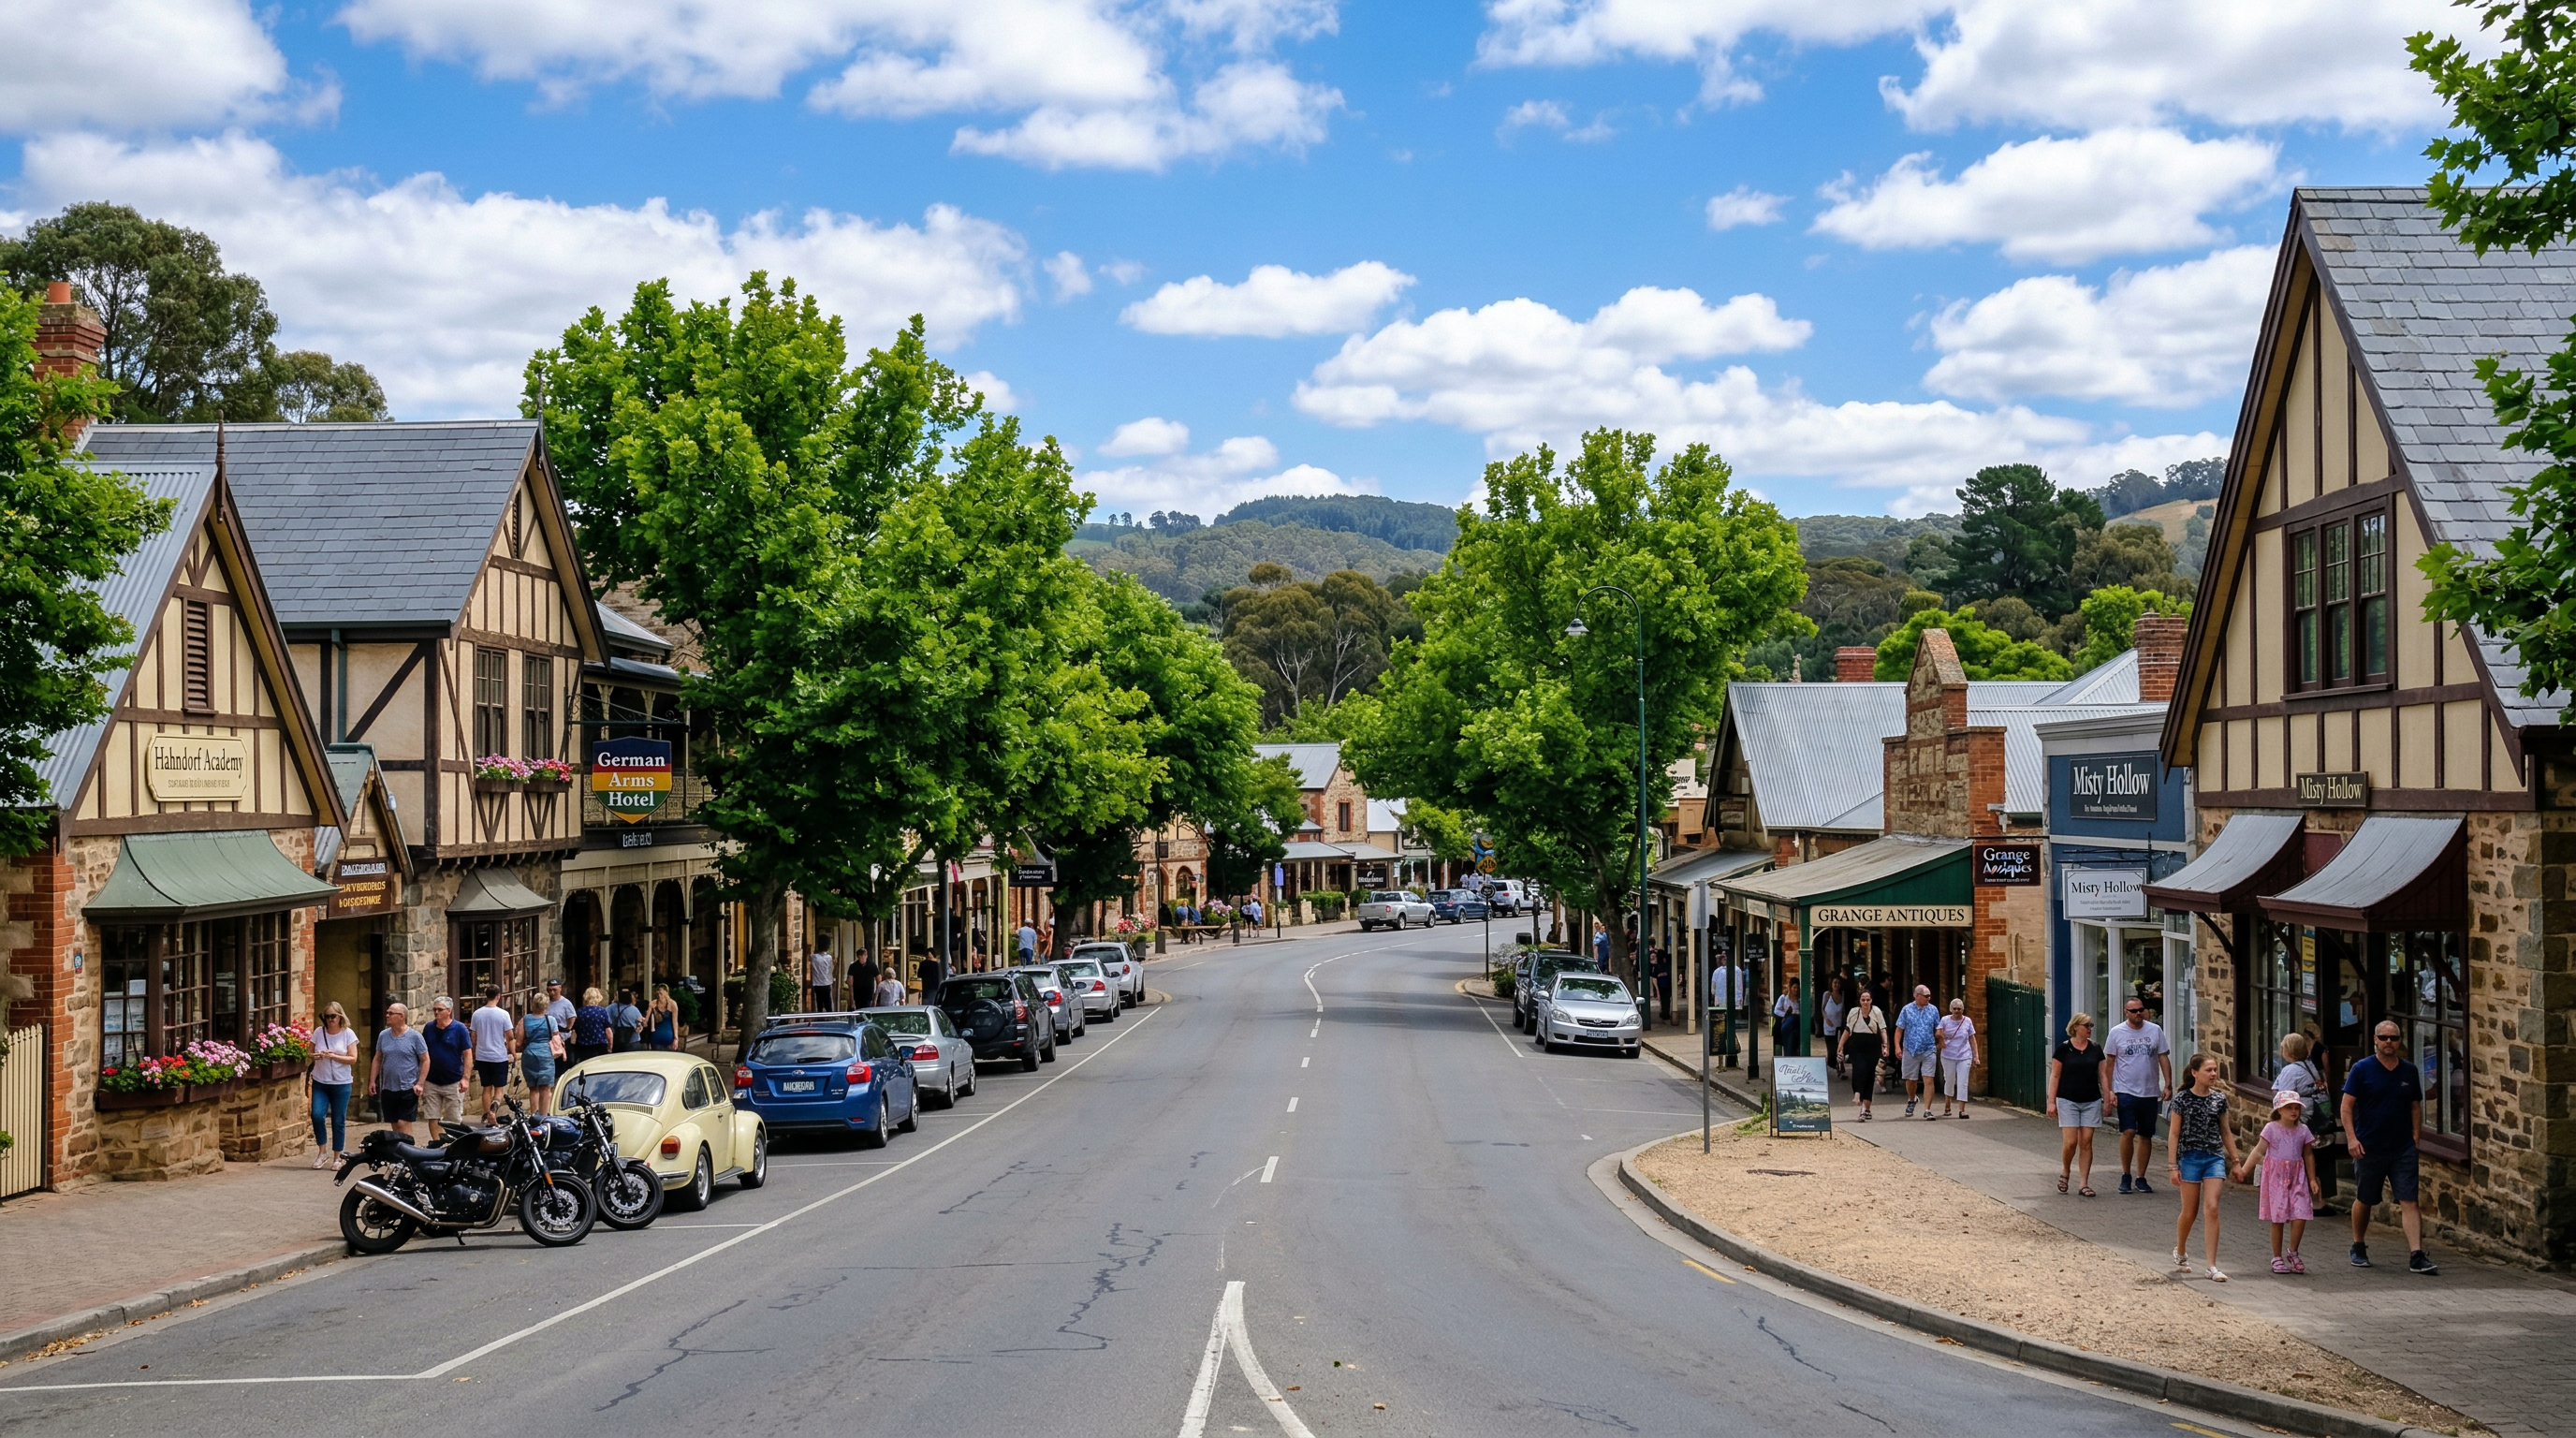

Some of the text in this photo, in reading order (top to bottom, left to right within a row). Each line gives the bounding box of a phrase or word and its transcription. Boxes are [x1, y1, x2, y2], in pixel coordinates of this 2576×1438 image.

[154, 746, 243, 779] Hahndorf Academy
[597, 752, 666, 767] German
[608, 772, 654, 787] Arms
[2072, 762, 2150, 804] Misty Hollow
[2327, 776, 2363, 799] Hollow
[607, 790, 655, 806] Hotel
[2104, 881, 2141, 893] Hollow
[1818, 909, 1965, 924] GRANGE ANTIQUES
